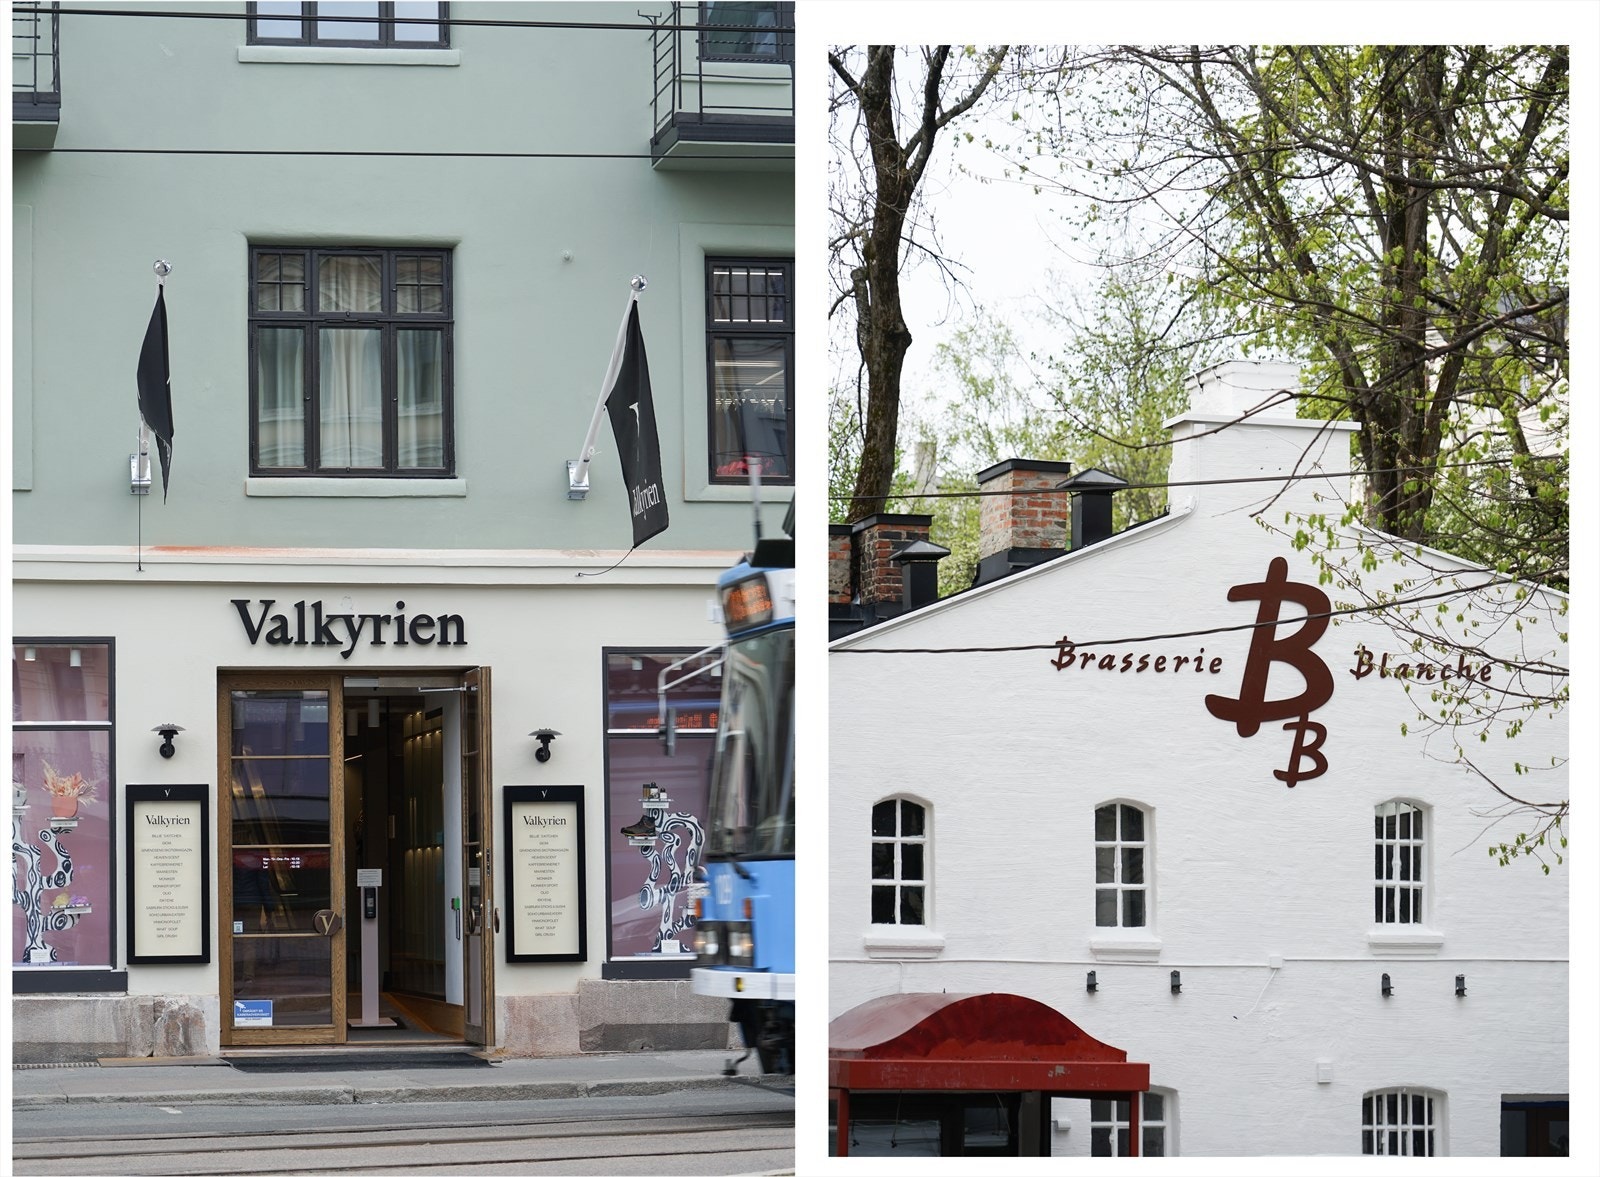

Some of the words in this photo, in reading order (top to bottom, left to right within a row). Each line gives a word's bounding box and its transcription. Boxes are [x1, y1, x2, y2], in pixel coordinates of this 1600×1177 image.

[230, 599, 468, 660] Valkyrien
[1050, 636, 1223, 674] Brasserie
[1349, 645, 1492, 682] Blanche
[1273, 711, 1329, 788] B
[146, 814, 190, 828] Valkyrien
[523, 815, 566, 828] Valkyrien
